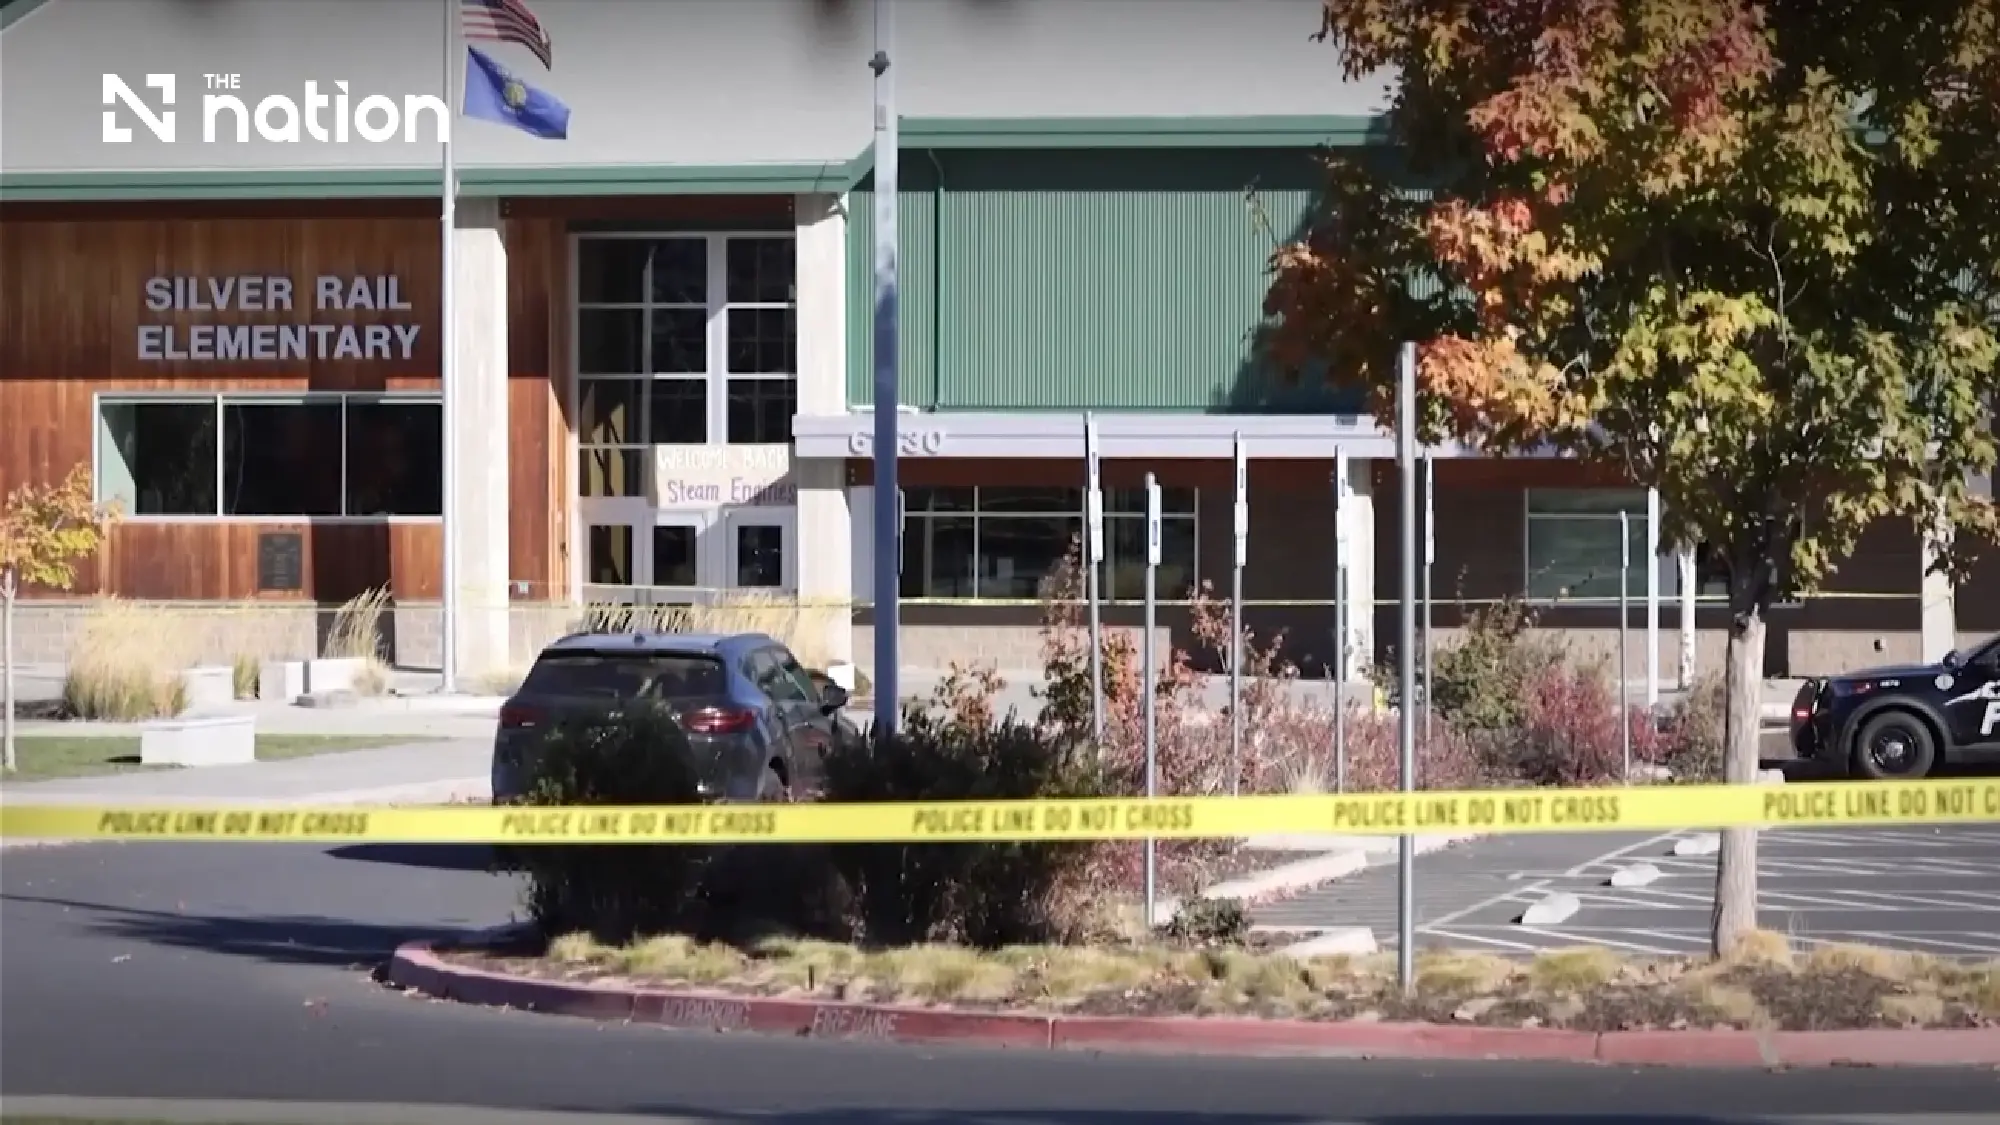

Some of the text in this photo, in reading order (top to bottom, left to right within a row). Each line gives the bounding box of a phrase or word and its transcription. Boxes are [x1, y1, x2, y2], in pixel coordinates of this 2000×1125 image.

[145, 275, 412, 311] SILVER RAIL
[137, 325, 420, 360] ELEMENTARY
[848, 428, 946, 455] 630
[657, 446, 727, 469] WELCOME
[667, 476, 796, 504] Steam Engines
[1334, 796, 1620, 826] POLICE LINE DO NOT CROSS
[1763, 791, 1836, 819] POLICE
[1845, 789, 1891, 818] LINE
[1899, 787, 1927, 816] DO
[1935, 786, 1976, 815] NOT
[98, 811, 369, 835] POLICE LINE DO NOT CROSS
[502, 811, 775, 835] POLICE LINE DO NOT CROSS
[912, 804, 1193, 833] POLICE LINE DO NOT CROSS
